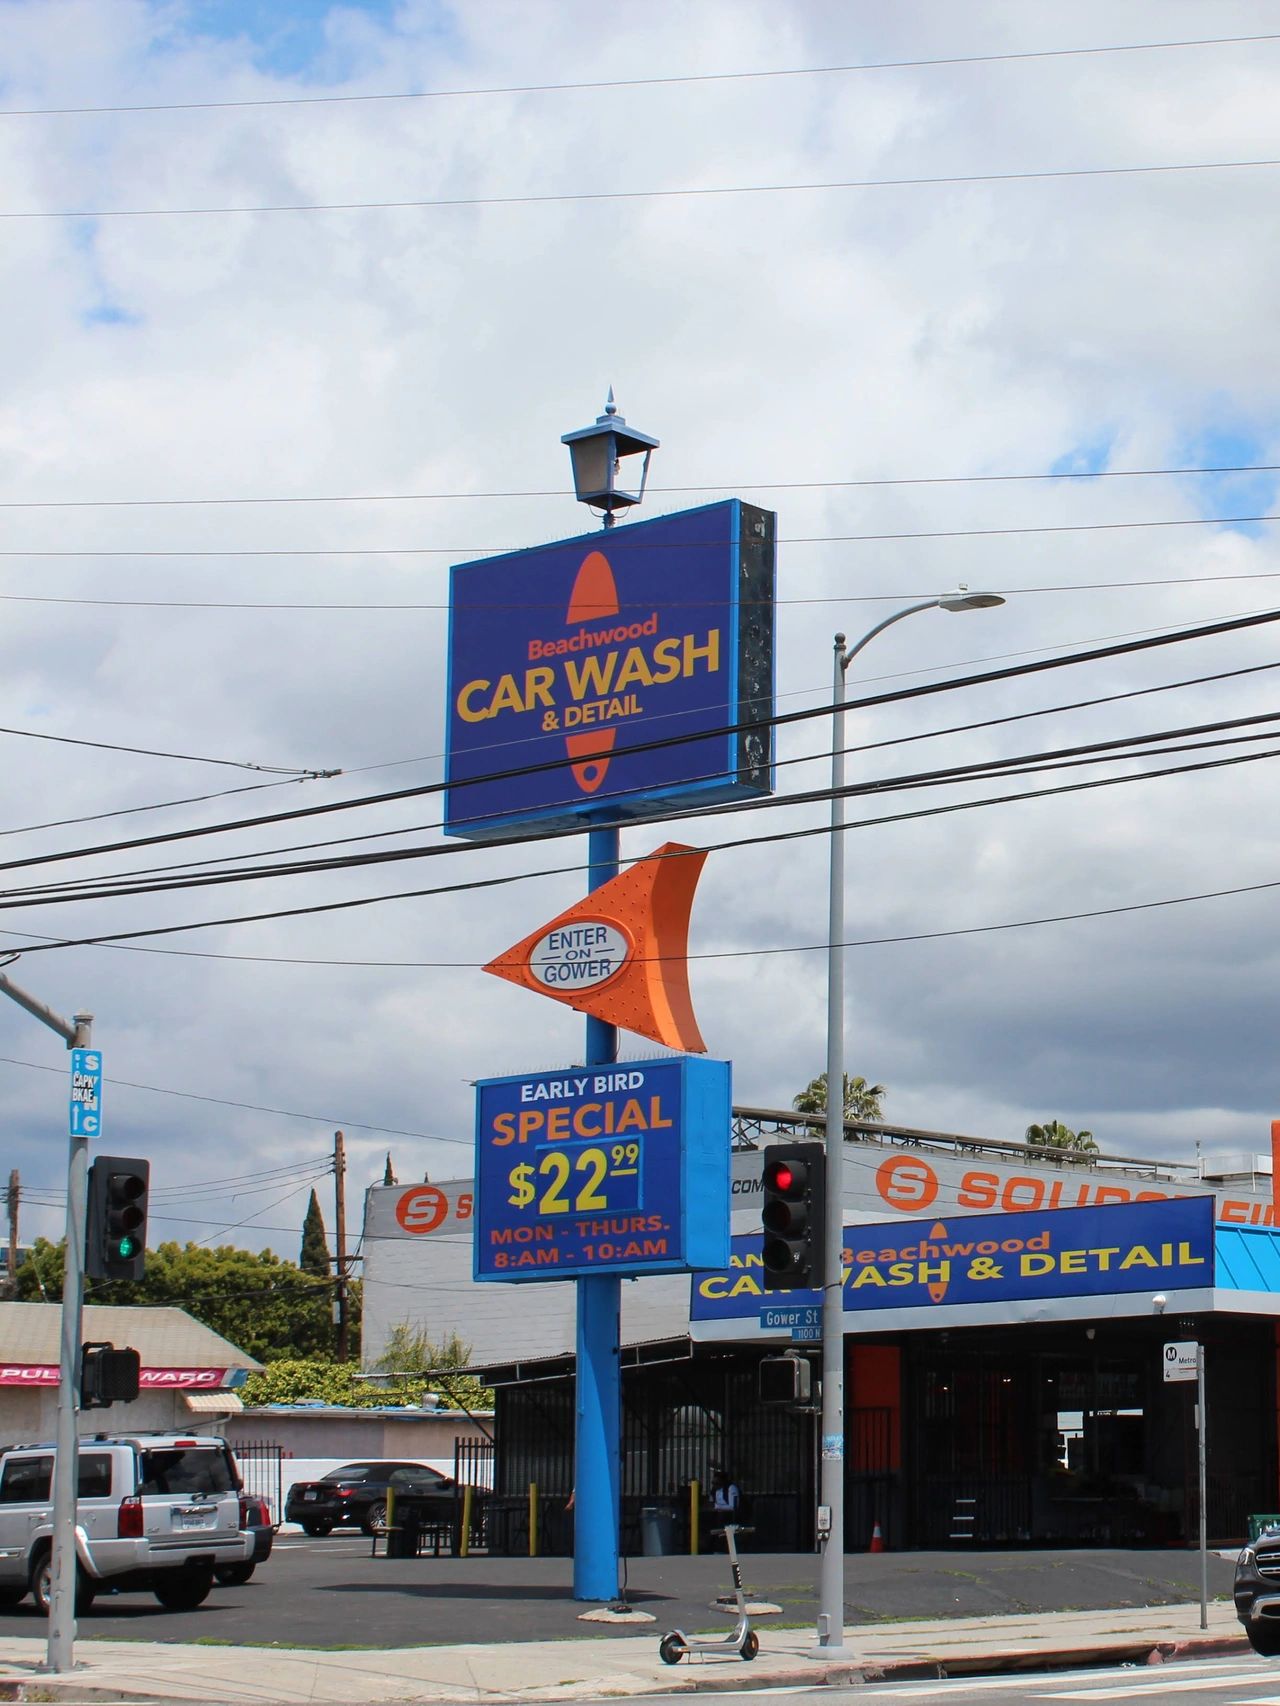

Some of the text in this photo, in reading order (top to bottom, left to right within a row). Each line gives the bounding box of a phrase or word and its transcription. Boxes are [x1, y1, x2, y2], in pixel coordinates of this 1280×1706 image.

[528, 612, 658, 661] Beachwood
[456, 629, 720, 723] CAR WASH
[542, 694, 642, 731] & DETAIL
[548, 926, 608, 951] ENTER
[565, 948, 591, 960] ON
[544, 959, 612, 984] GOWER
[521, 1071, 644, 1102] EARLY BIRD
[491, 1096, 672, 1146] SPECIAL
[490, 1223, 553, 1245] MON
[576, 1216, 670, 1237] THURS.
[494, 1250, 559, 1269] 8:AM
[582, 1239, 667, 1261] 10:AM
[730, 1253, 764, 1268] AN
[842, 1231, 1050, 1264] Beachwood
[699, 1275, 792, 1299] CA
[966, 1257, 1004, 1281] &
[1021, 1242, 1205, 1278] DETAIL
[766, 1310, 818, 1326] Gower St
[1, 1368, 61, 1380] PUL
